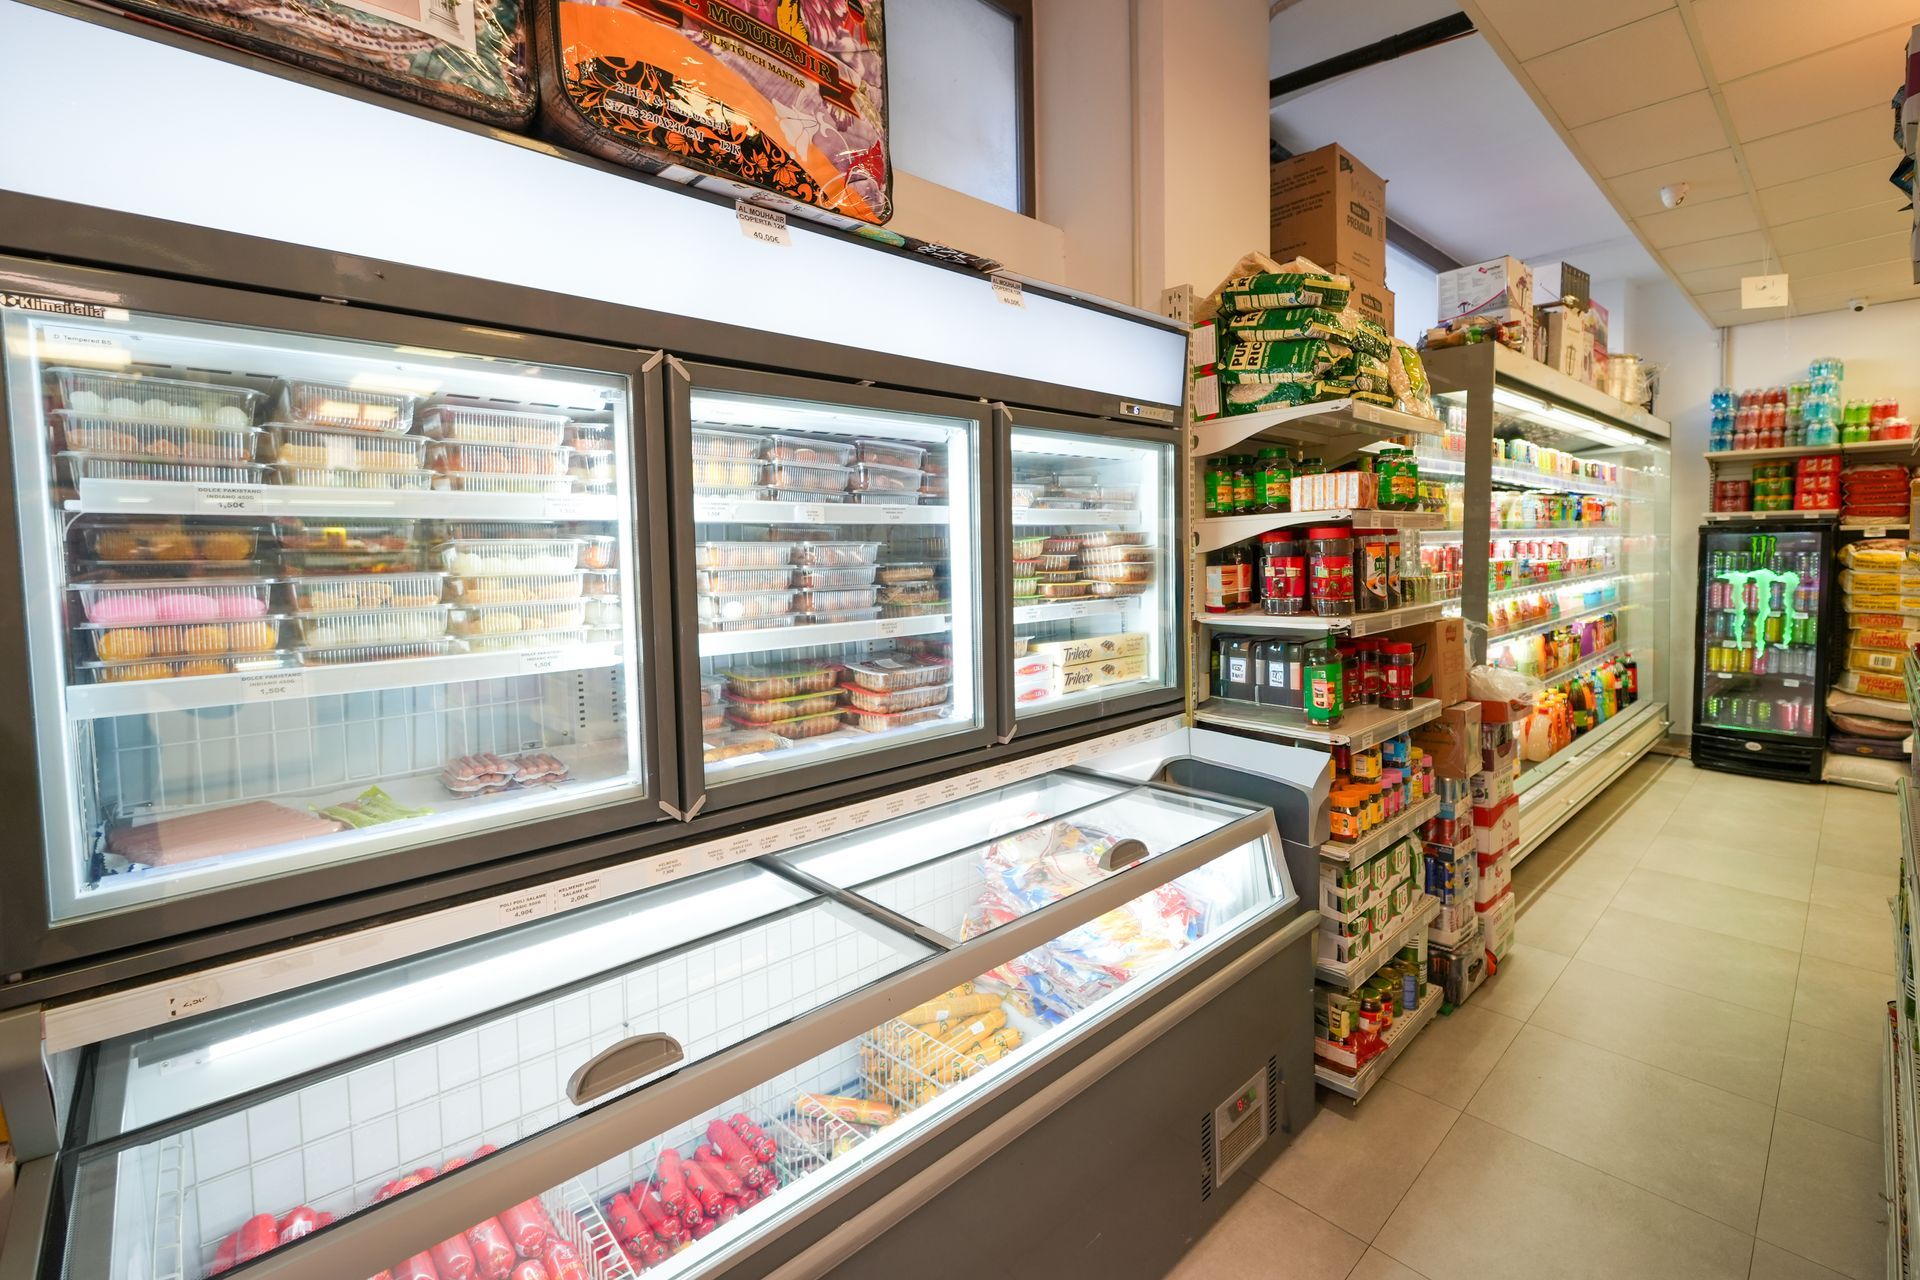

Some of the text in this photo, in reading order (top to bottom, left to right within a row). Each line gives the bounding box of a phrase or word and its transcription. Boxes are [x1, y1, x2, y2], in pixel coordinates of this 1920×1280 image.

[707, 1, 832, 82] MOUHAJIR
[702, 30, 806, 89] SILK TOUCH MANTAS
[719, 140, 741, 156] 12K
[738, 205, 785, 224] AL MOUHAJIR
[739, 213, 772, 227] COPERTA
[1346, 214, 1372, 238] PREMIUM
[20, 296, 104, 318] Klimaitalia
[526, 893, 547, 901] SALAME
[562, 889, 583, 897] SALAME
